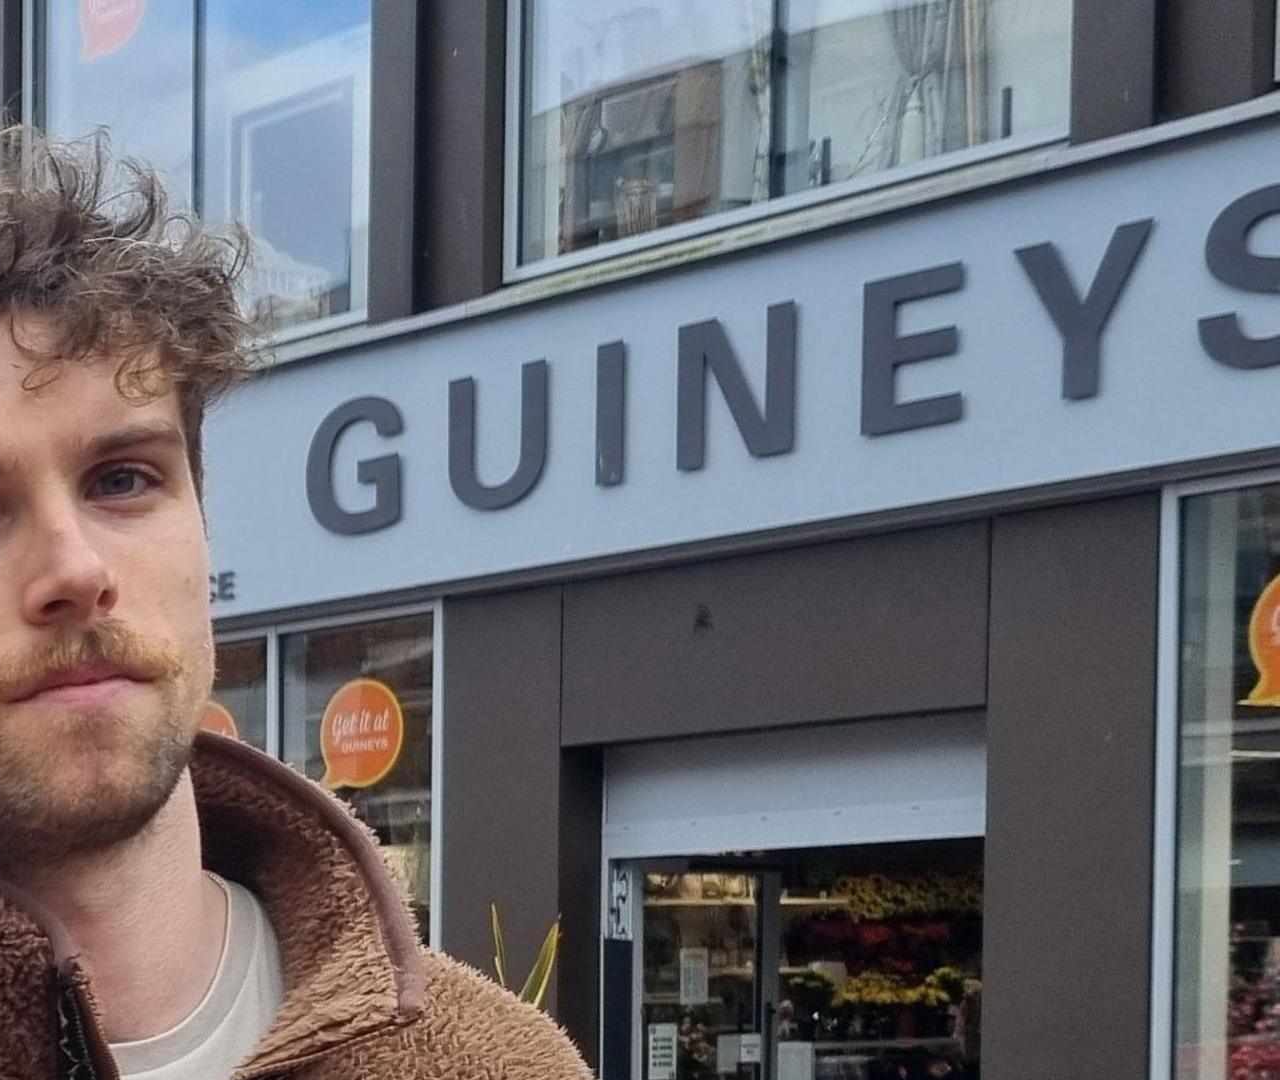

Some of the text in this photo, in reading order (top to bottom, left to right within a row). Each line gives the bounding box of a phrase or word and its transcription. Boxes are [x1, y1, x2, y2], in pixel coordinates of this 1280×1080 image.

[305, 184, 1280, 537] GUINEYS
[332, 707, 389, 744] Get it at
[342, 738, 388, 754] GUINEYS
